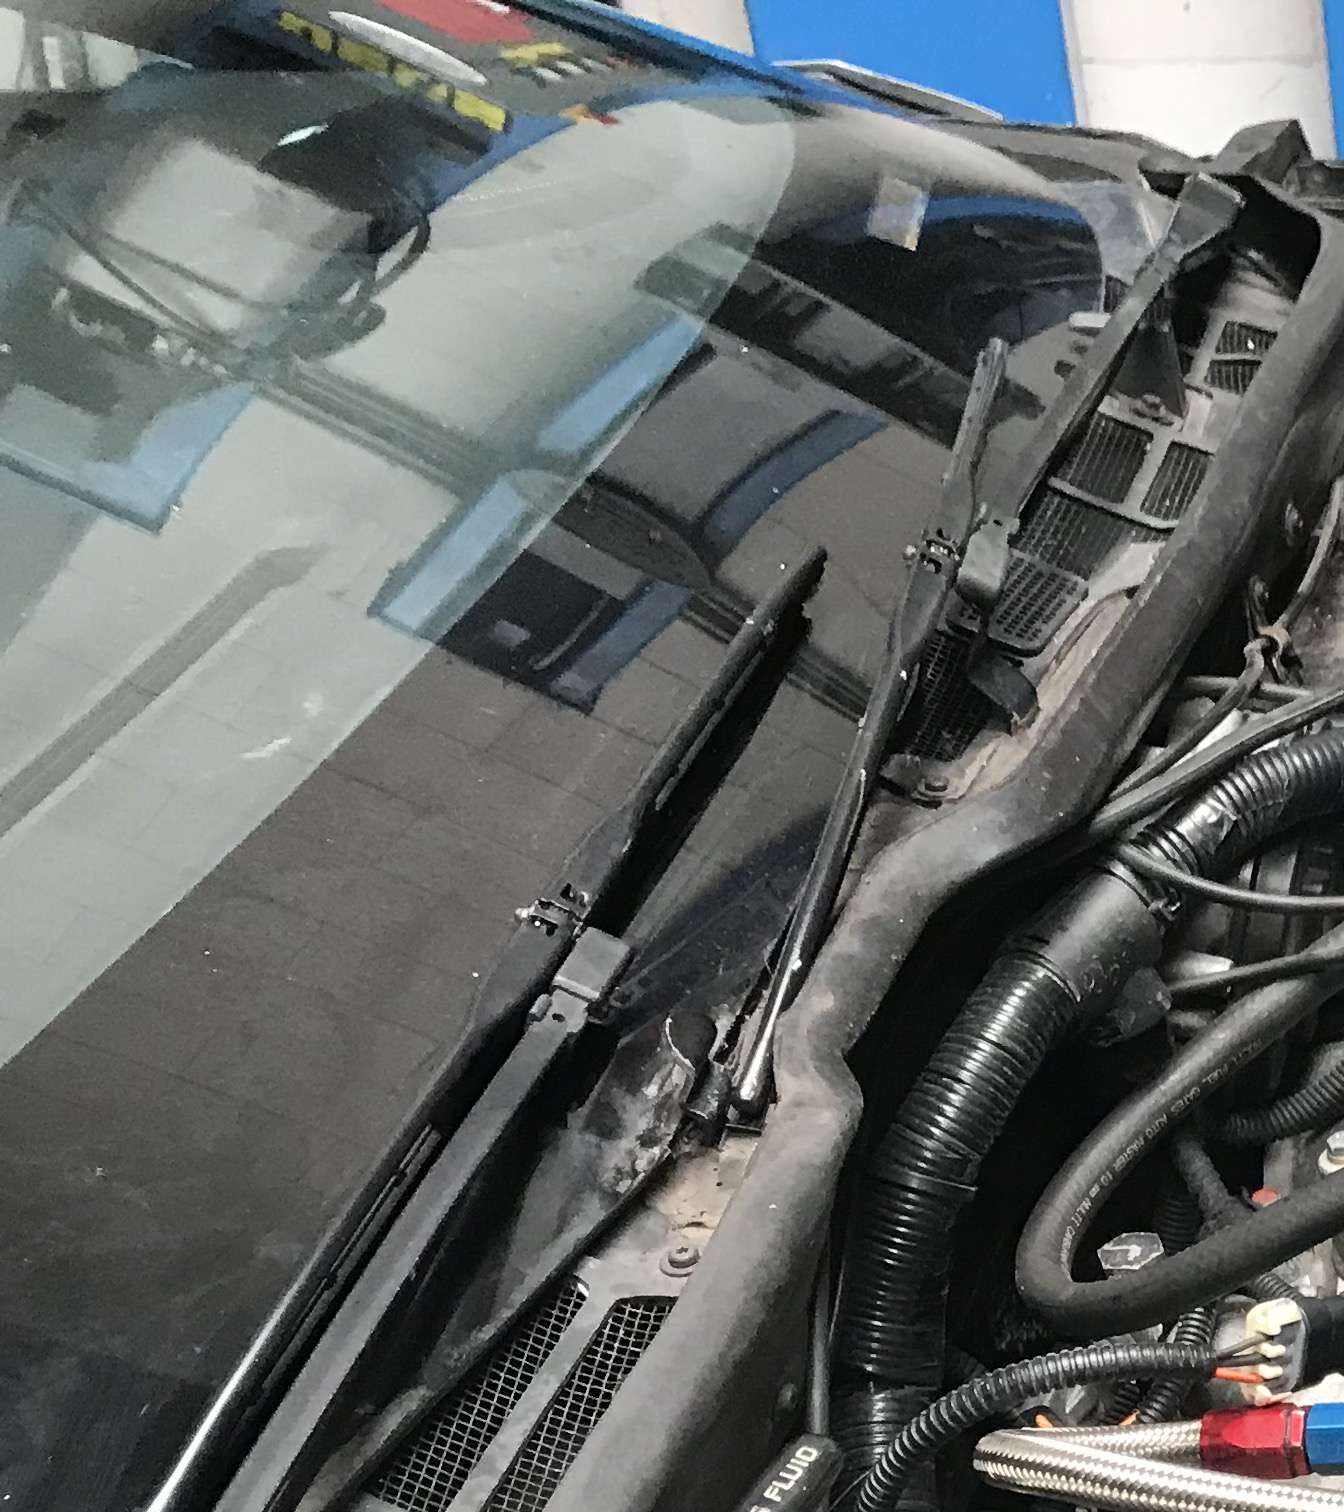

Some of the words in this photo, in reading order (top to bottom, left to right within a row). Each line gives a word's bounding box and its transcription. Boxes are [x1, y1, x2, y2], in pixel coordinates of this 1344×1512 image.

[1171, 1086, 1200, 1116] GATES
[1145, 1113, 1168, 1139] AUTO
[1113, 1136, 1145, 1172] MASTER
[763, 1446, 818, 1502] FLUID
